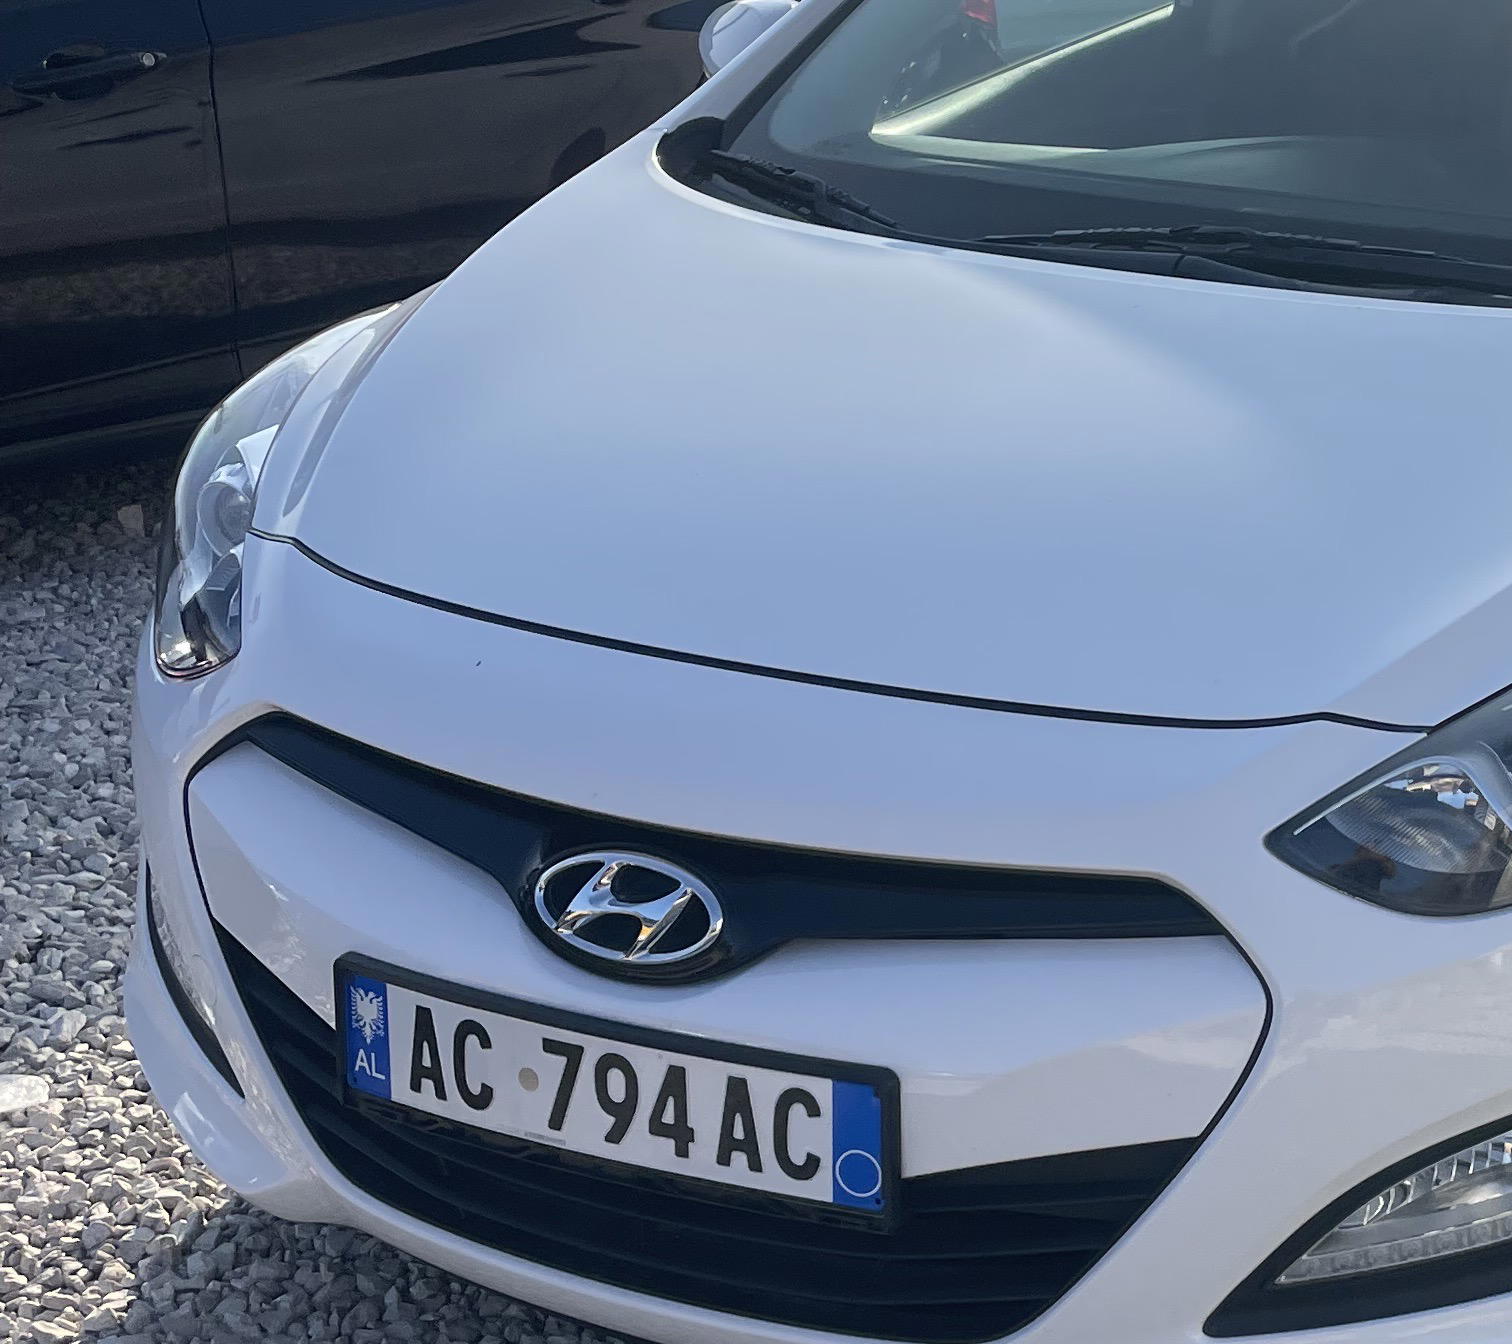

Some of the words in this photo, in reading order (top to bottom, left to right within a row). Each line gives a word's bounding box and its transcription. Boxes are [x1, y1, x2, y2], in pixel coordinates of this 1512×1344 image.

[354, 1048, 386, 1080] AL
[409, 1005, 495, 1111] AC
[542, 1037, 695, 1158] 794
[716, 1075, 822, 1181] AC
